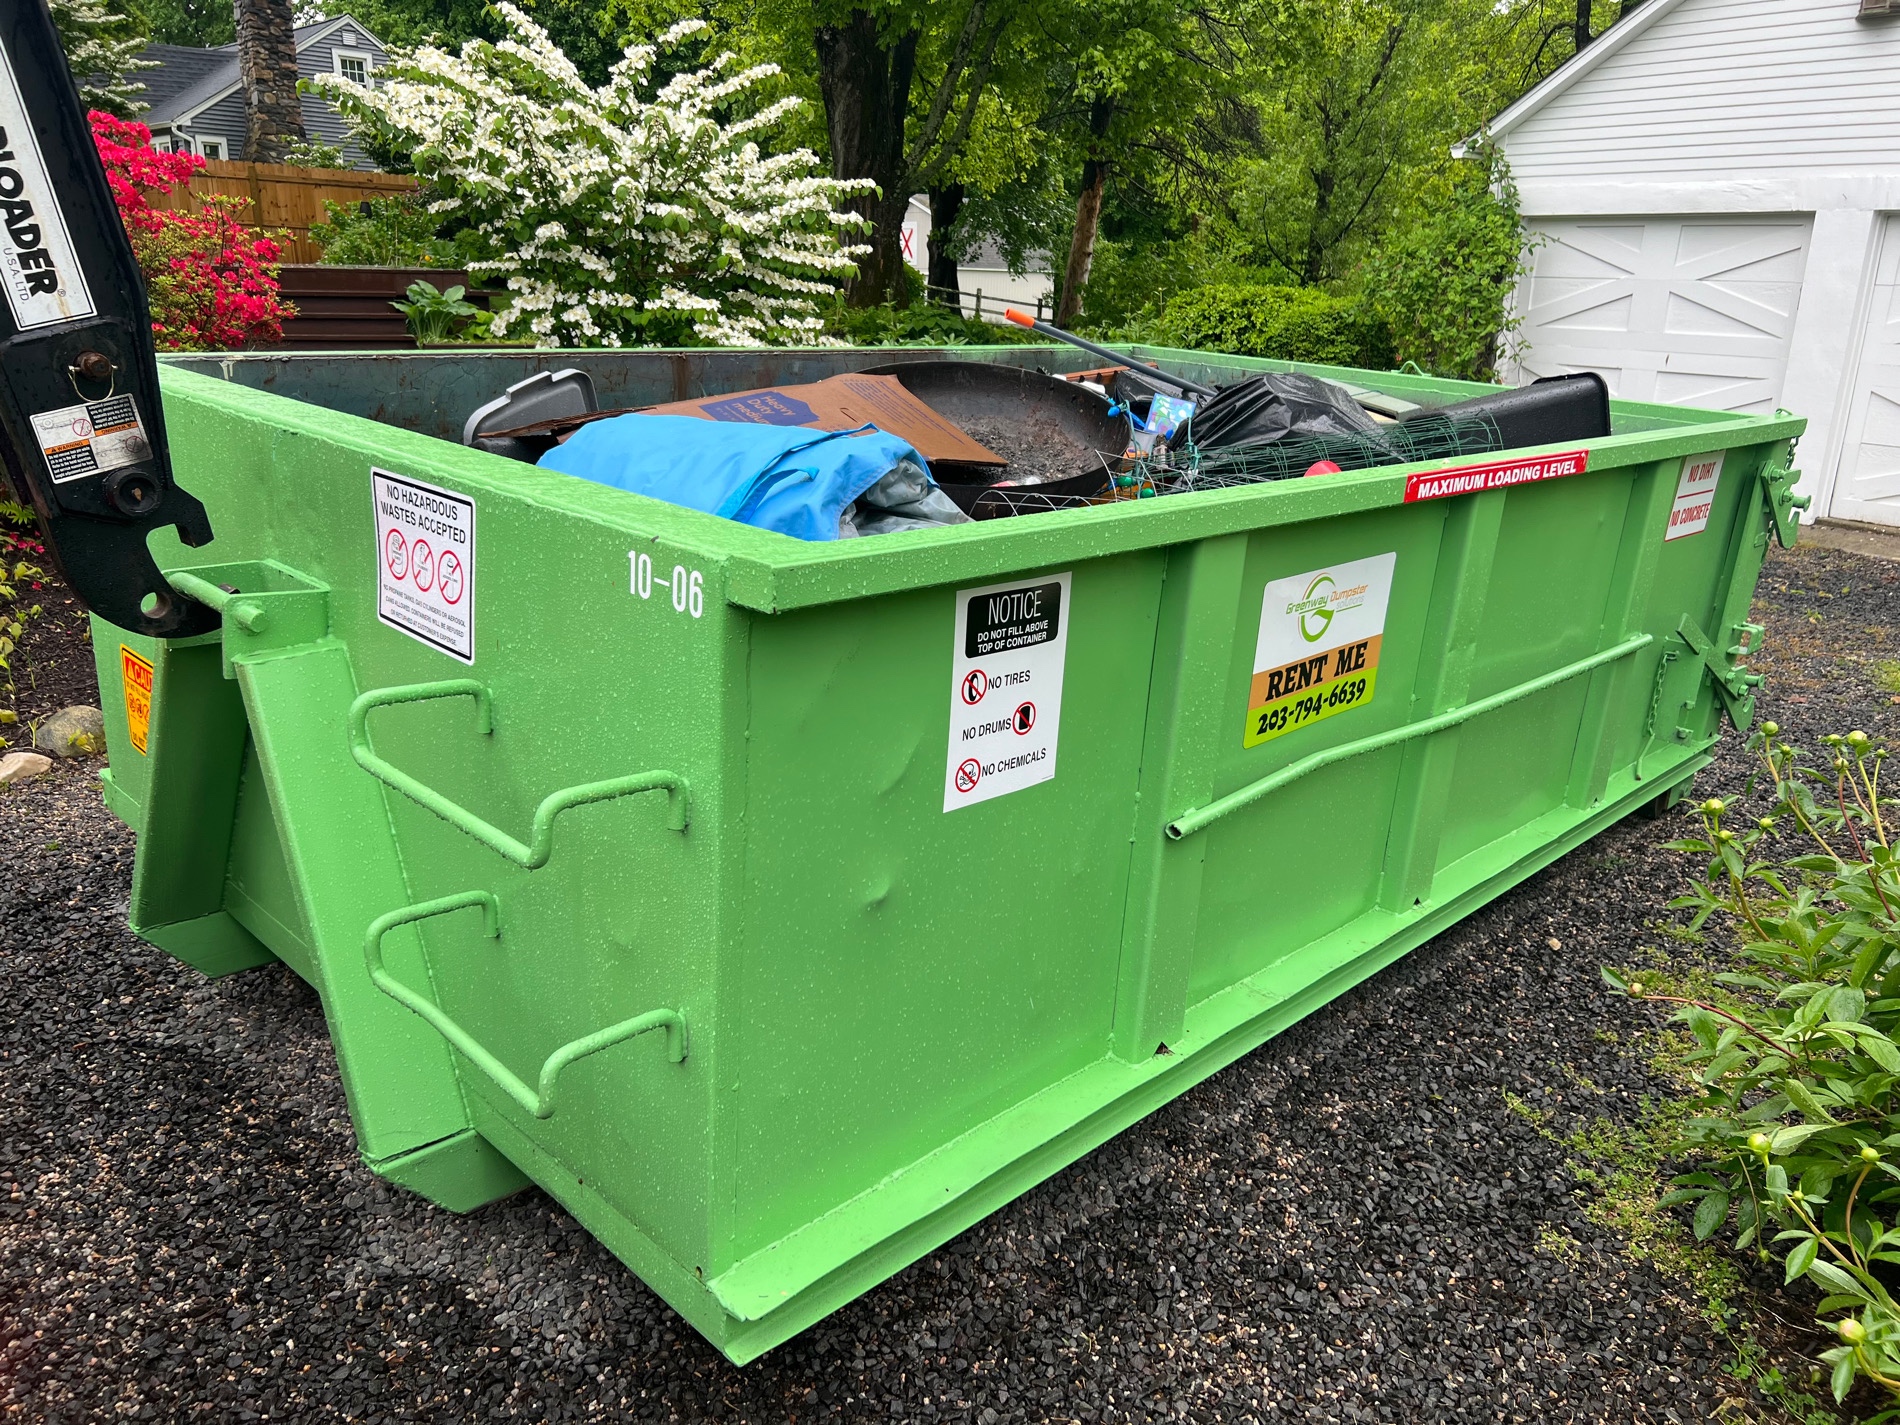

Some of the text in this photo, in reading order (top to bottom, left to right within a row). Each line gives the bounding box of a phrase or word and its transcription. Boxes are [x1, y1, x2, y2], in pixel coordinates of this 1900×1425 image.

[0, 125, 58, 297] OADER
[3, 247, 20, 279] U.S.A.
[15, 281, 29, 304] LTD.
[746, 398, 775, 415] Duty
[761, 395, 796, 416] Heavy
[1417, 460, 1577, 499] MAXIMUM LOADING LEVEL
[1687, 461, 1716, 483] NO DIRT
[386, 484, 458, 521] NO HAZARDOUS
[1669, 502, 1710, 527] NO CONCRETE
[380, 500, 466, 544] WASTES ACCEPTED
[628, 550, 703, 619] 10-06
[1286, 584, 1369, 615] Greenway Dumpster
[988, 590, 1043, 625] NOTICE
[977, 620, 1049, 643] DO NOT FILL ABOVE
[977, 631, 1047, 654] TOP OF CONTAINER
[988, 669, 1031, 691] NO TIRES
[1265, 641, 1368, 702] RENT ME
[1256, 678, 1366, 736] 203-794-6639
[962, 718, 1012, 741] NO DRUMS
[981, 747, 1046, 778] NO CHEMICALS
